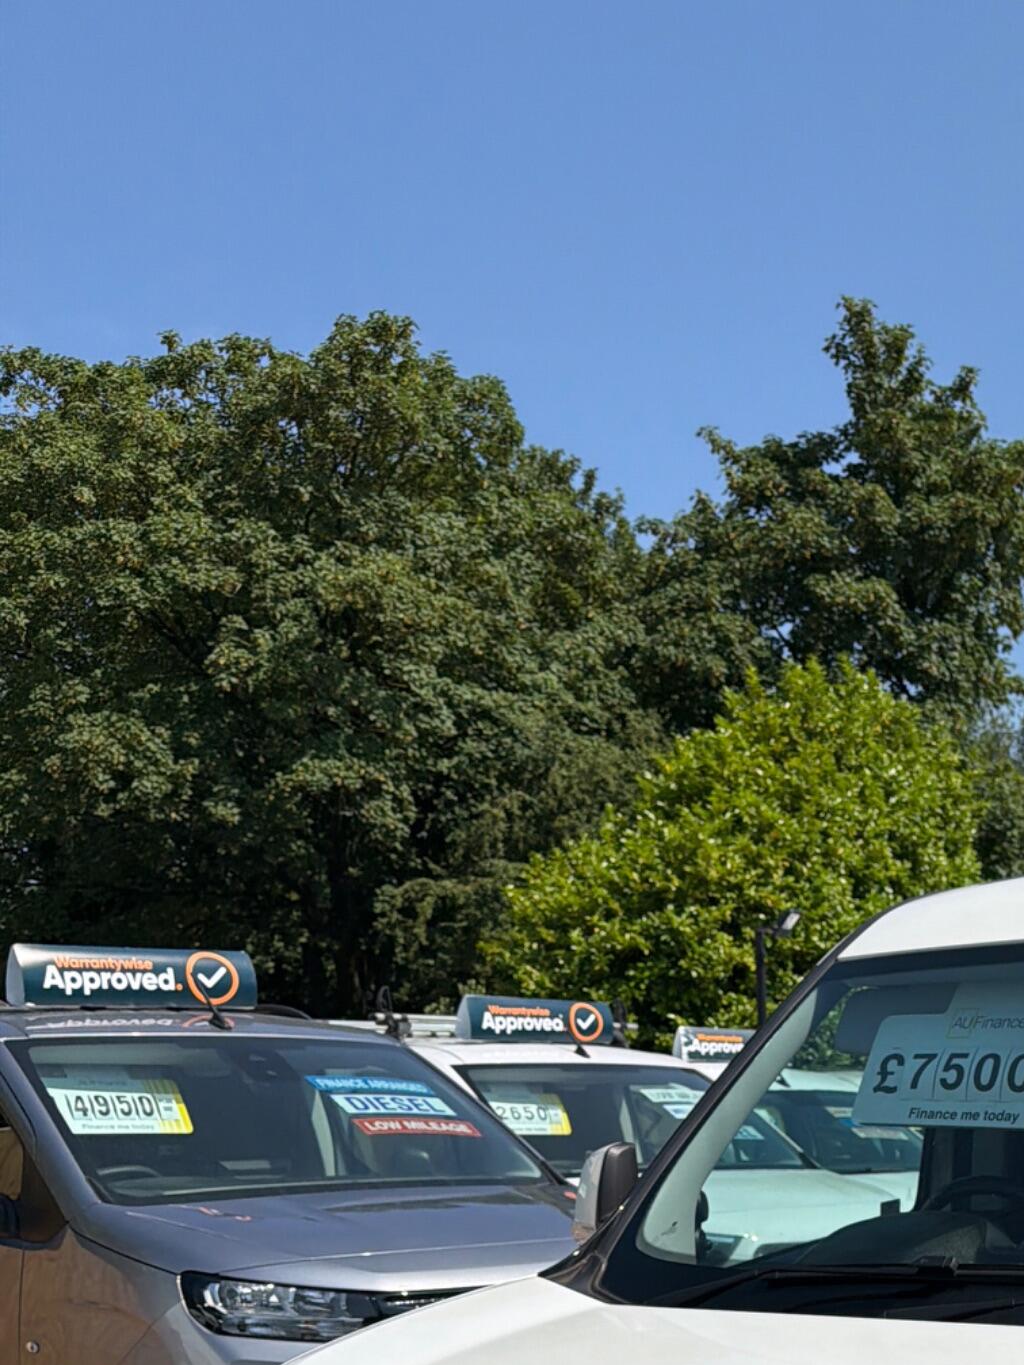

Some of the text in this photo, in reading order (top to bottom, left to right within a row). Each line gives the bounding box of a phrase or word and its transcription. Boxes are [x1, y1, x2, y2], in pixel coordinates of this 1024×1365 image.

[53, 956, 153, 972] Warrantywise
[345, 1097, 446, 1113] DIESEL
[908, 1107, 1020, 1124] Finance me today
[364, 1121, 472, 1134] LOW MILEAGE
